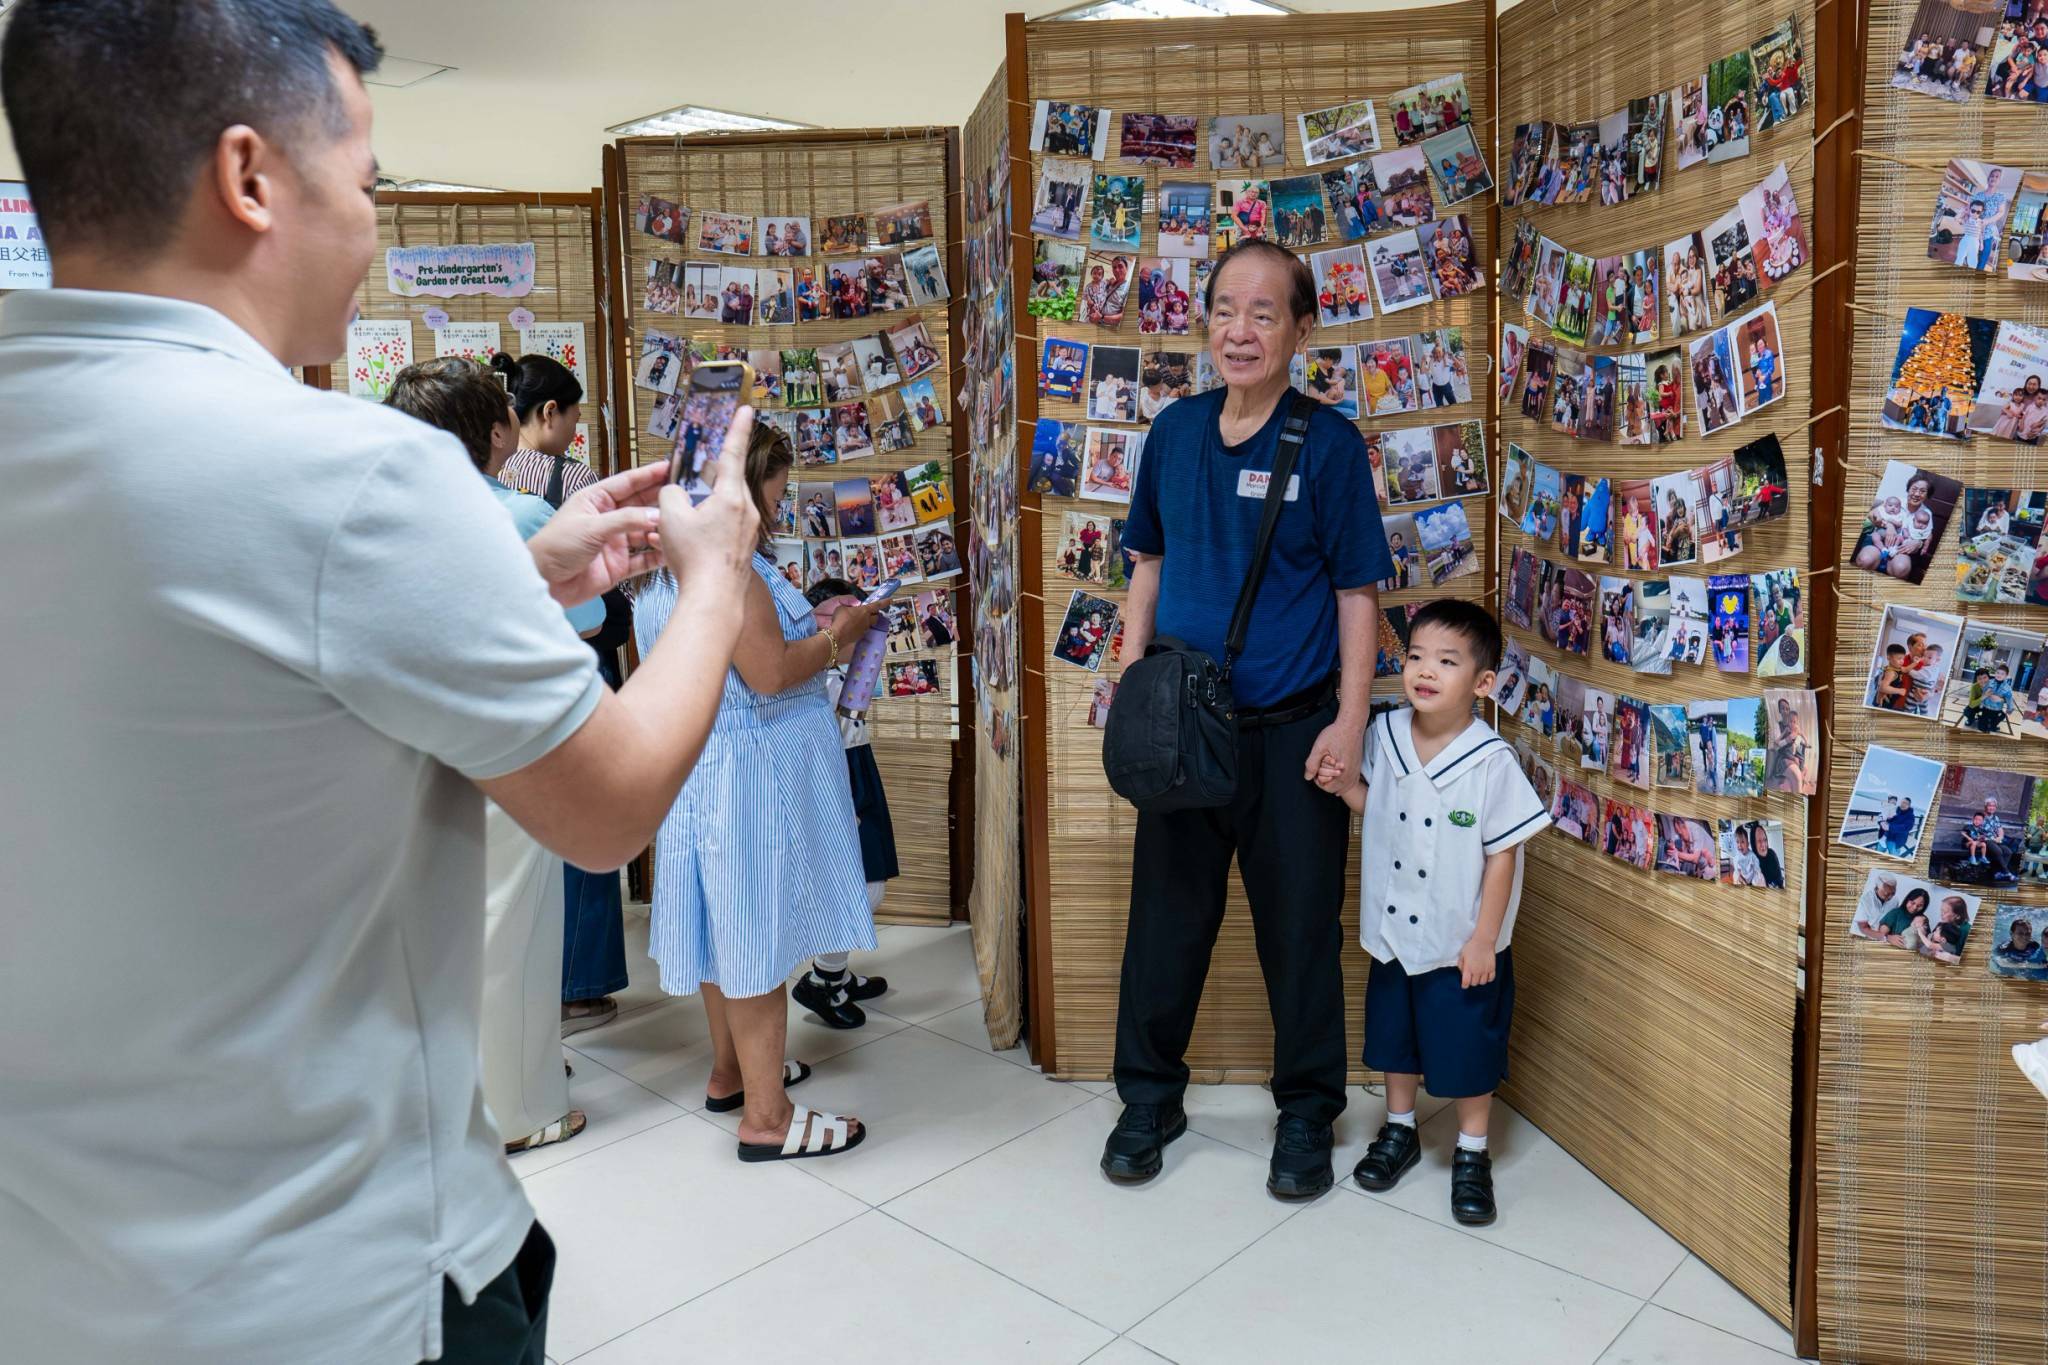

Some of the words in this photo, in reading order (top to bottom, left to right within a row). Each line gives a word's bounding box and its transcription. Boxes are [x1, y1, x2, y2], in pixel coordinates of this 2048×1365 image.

[418, 263, 502, 275] Pre-Kindergarten's
[416, 275, 447, 287] Garden
[450, 275, 460, 286] of
[461, 275, 486, 286] Great
[488, 274, 509, 284] Love
